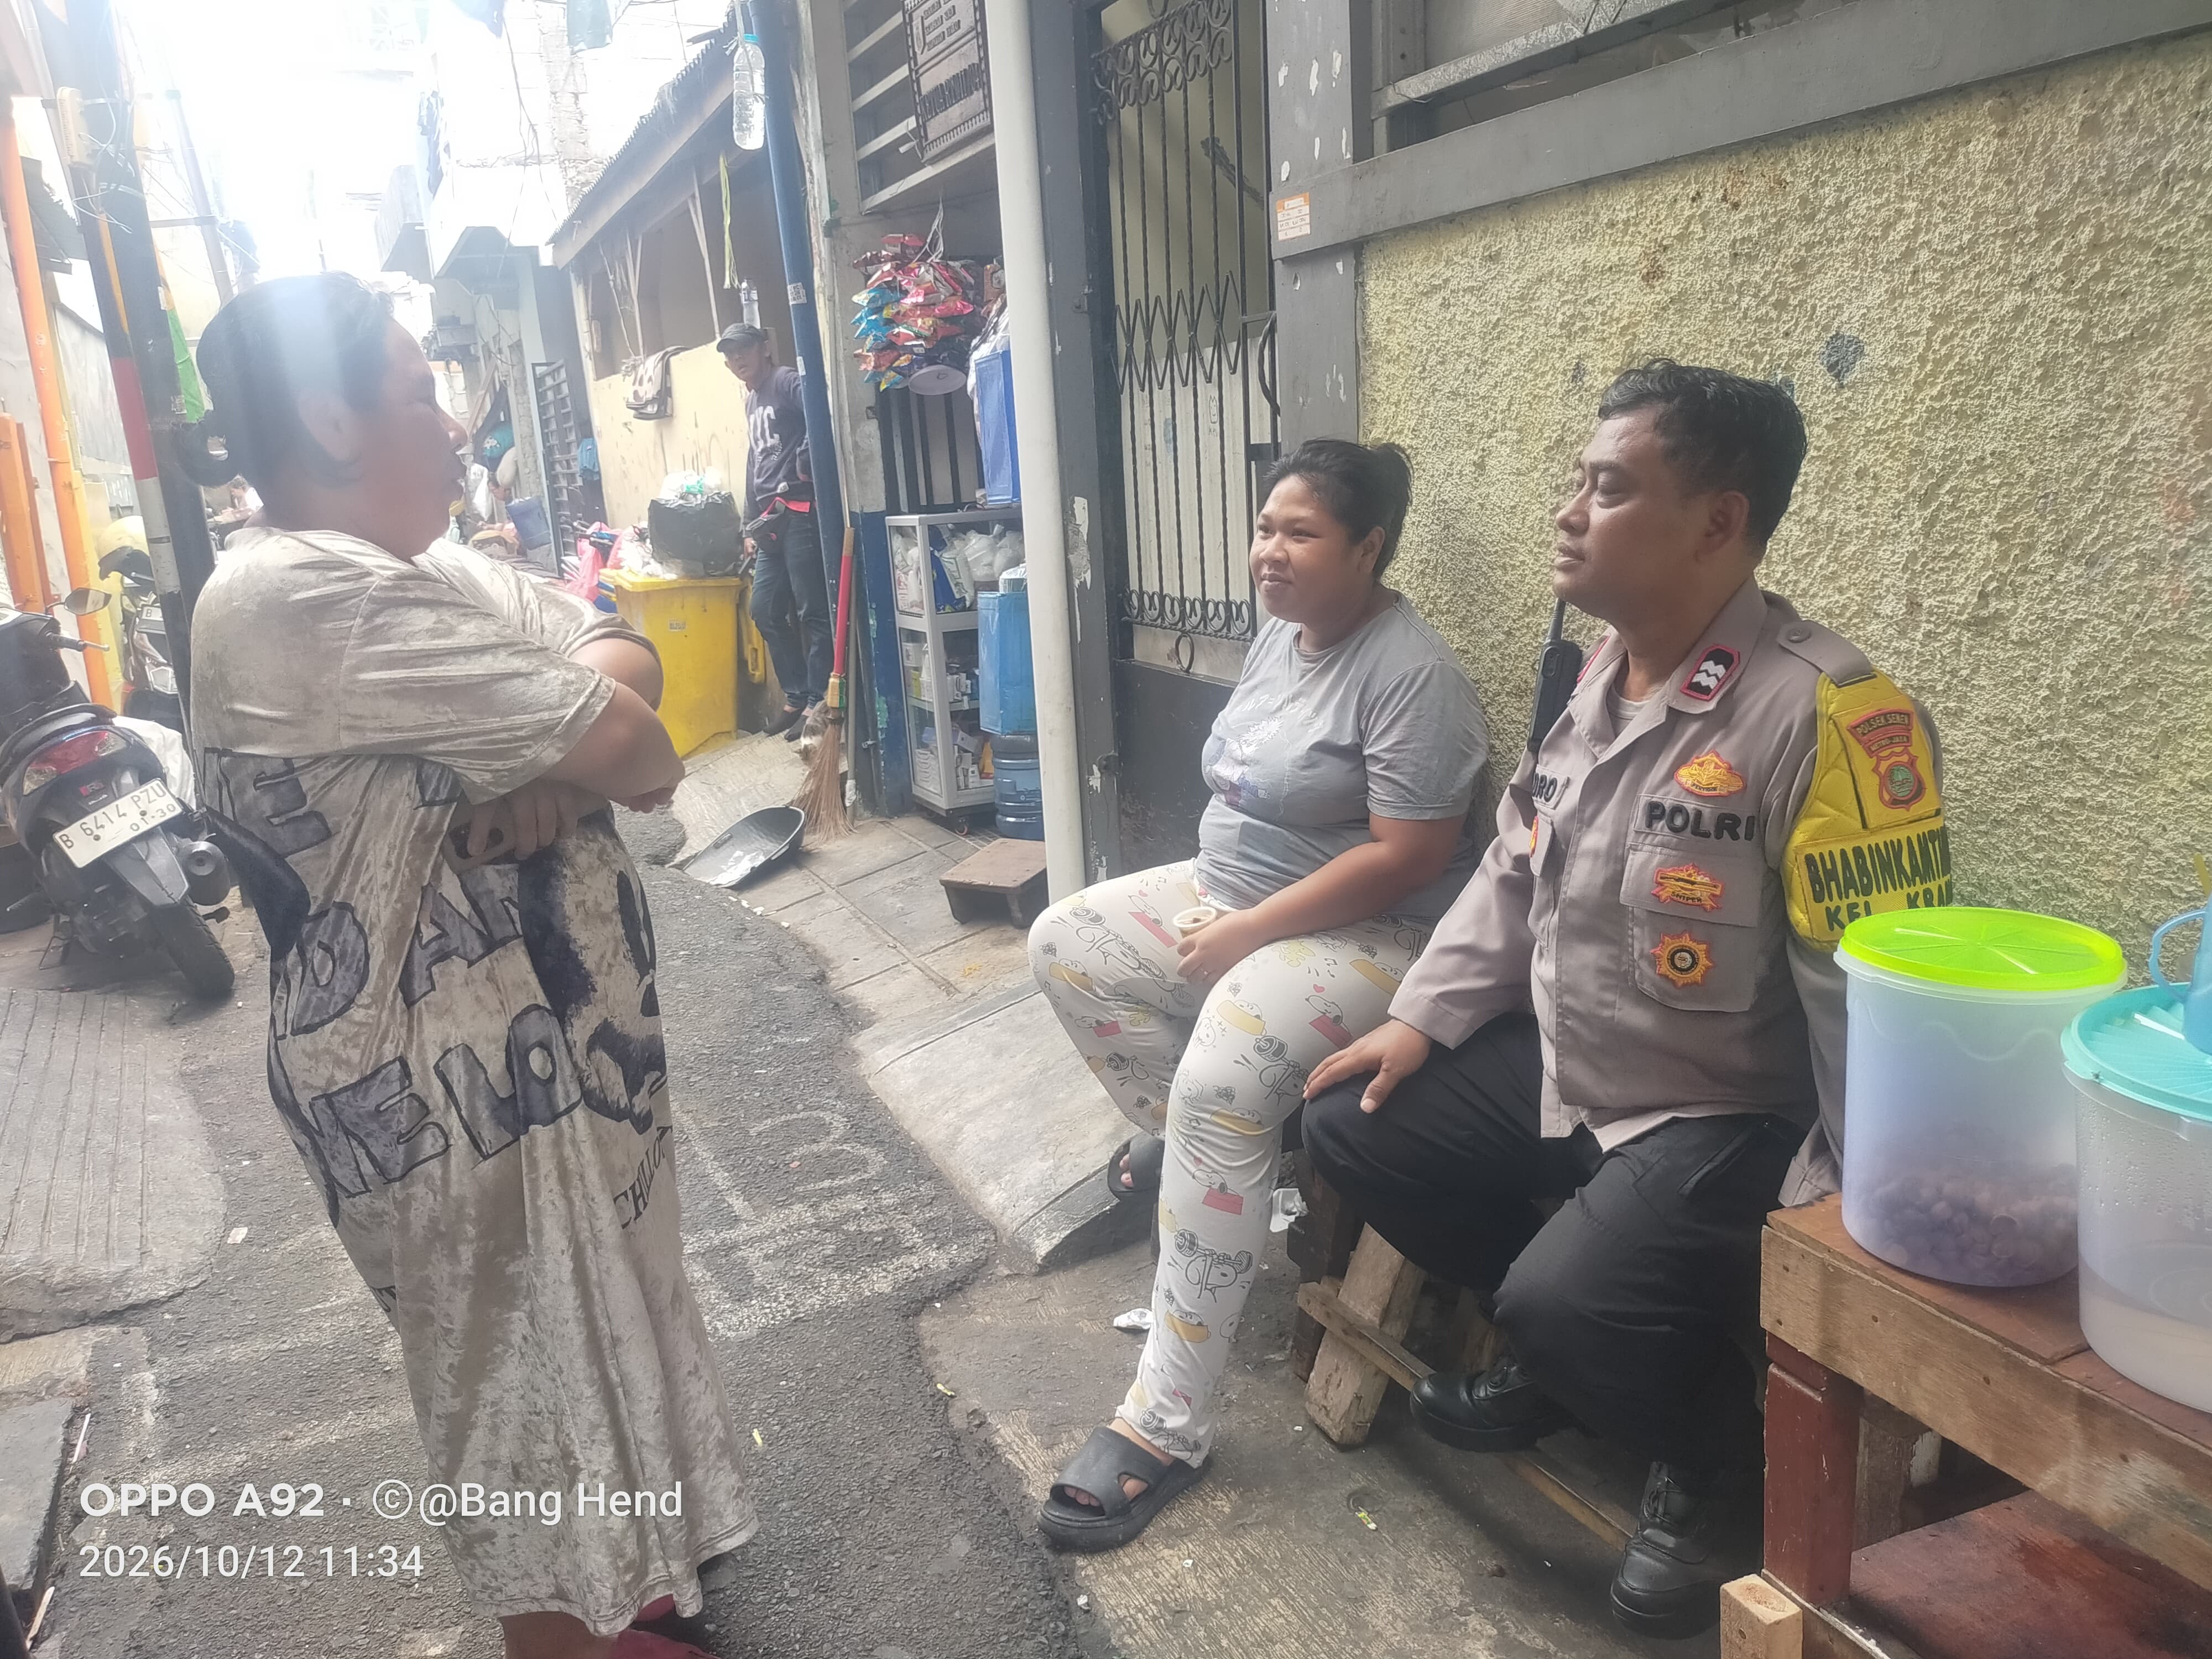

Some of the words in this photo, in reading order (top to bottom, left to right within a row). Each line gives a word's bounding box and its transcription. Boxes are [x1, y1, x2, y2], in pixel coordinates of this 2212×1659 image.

[58, 833, 74, 849] B
[80, 804, 127, 837] 6414
[131, 782, 166, 809] PZU
[1645, 801, 1755, 841] POLRI
[1672, 891, 1702, 904] SNIPER
